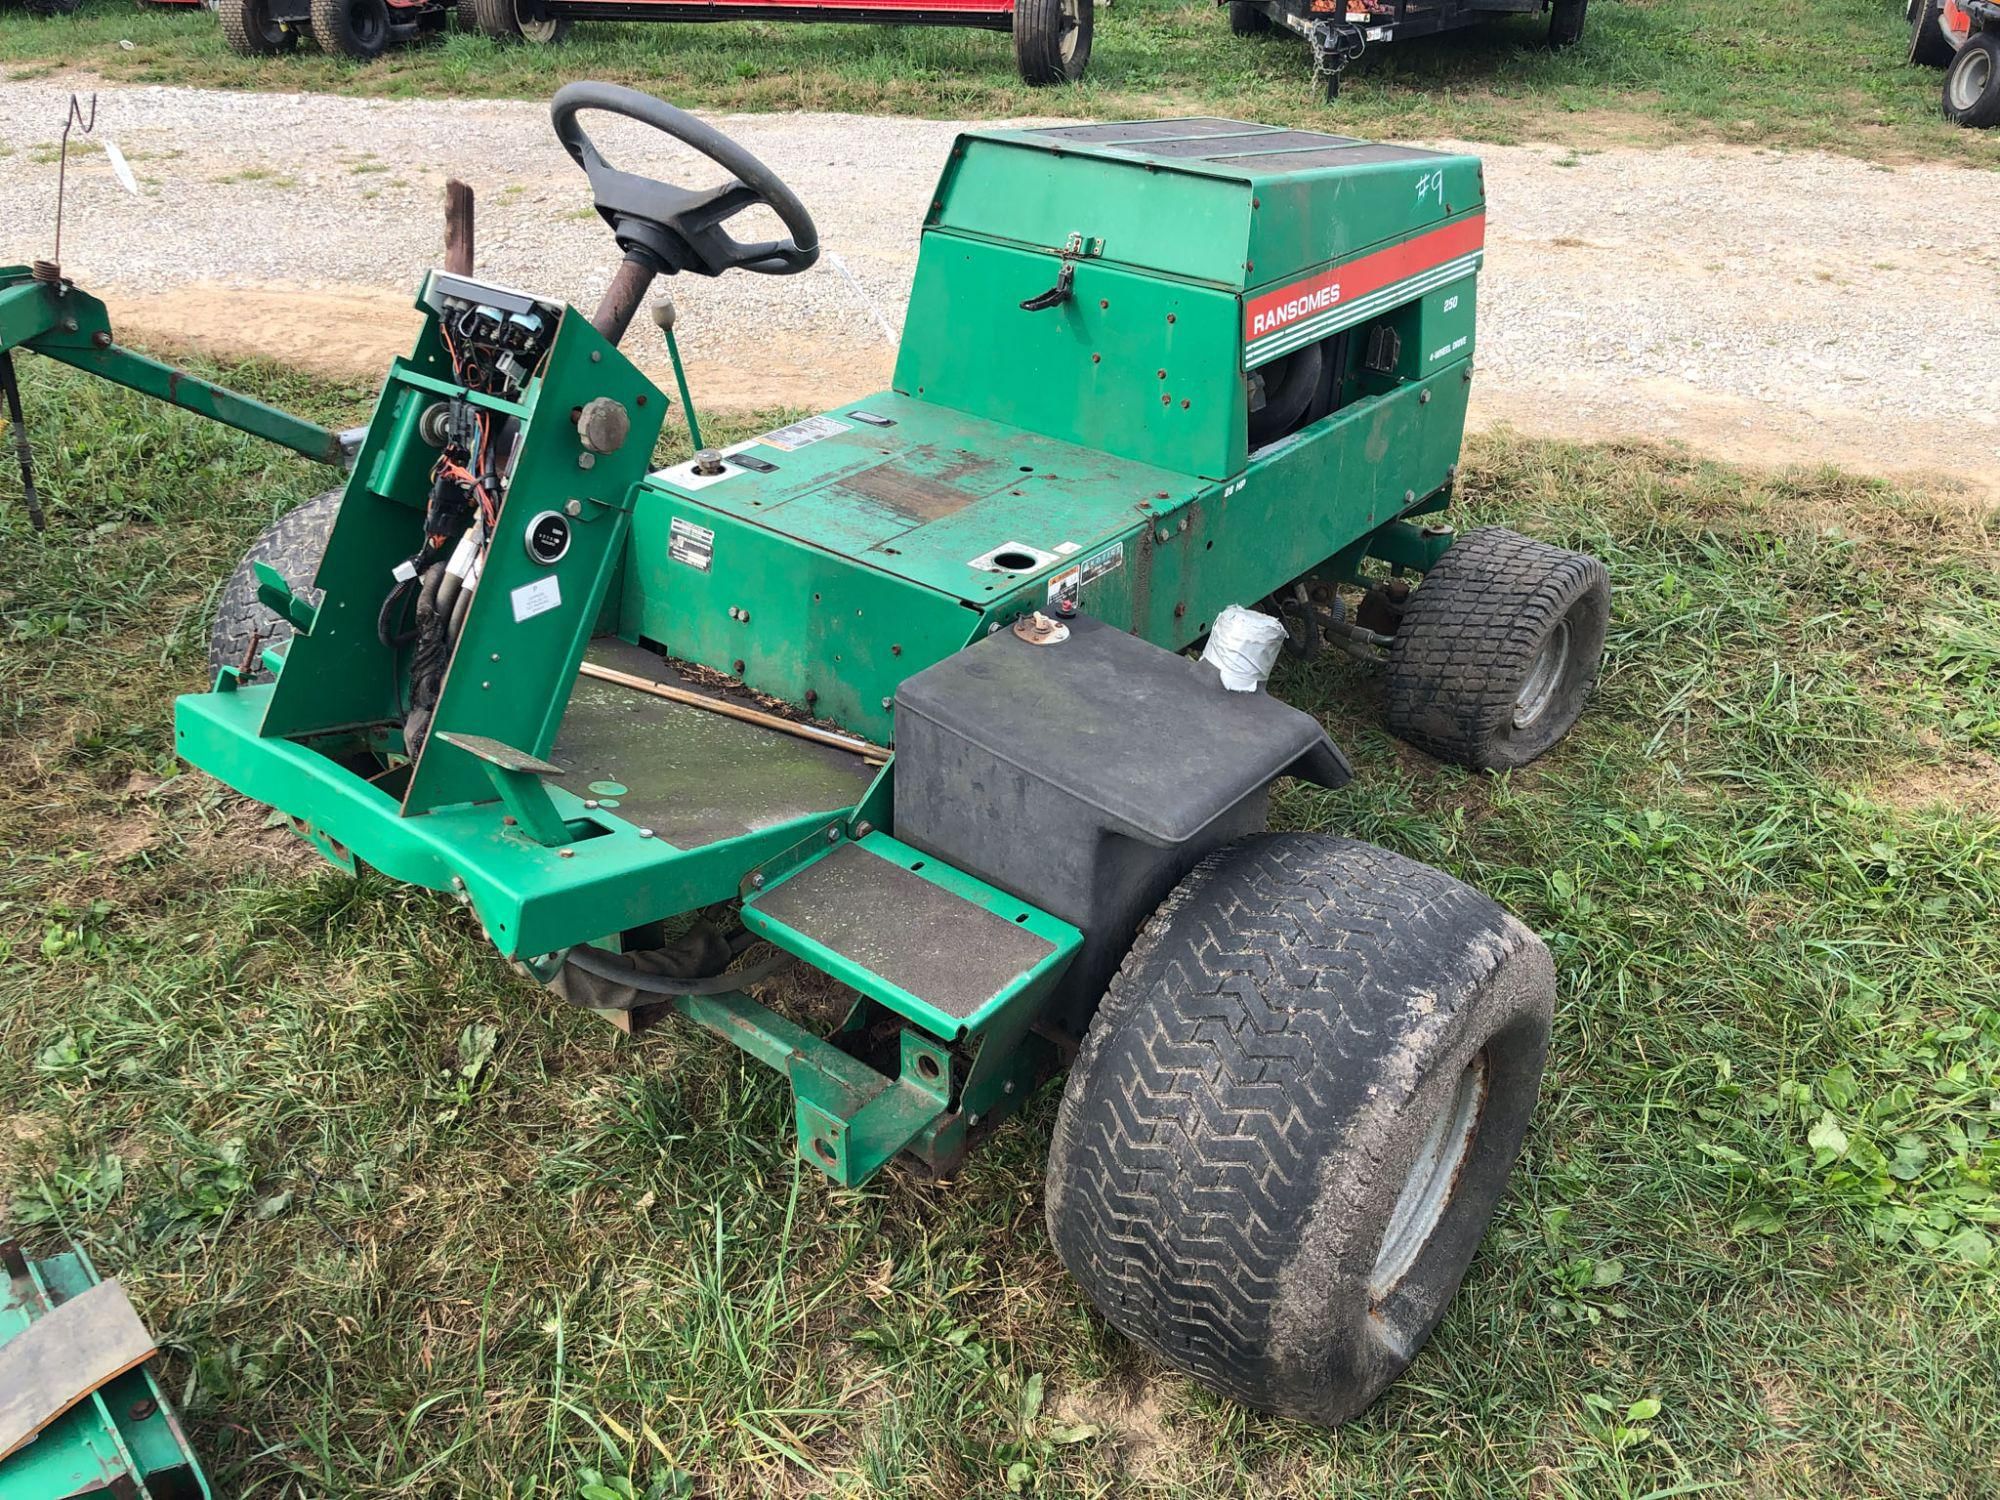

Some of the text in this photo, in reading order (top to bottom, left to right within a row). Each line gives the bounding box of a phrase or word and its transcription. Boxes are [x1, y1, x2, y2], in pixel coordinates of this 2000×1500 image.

[1415, 169, 1443, 205] #9
[1253, 284, 1340, 334] RANSOMES
[1444, 295, 1458, 312] 250
